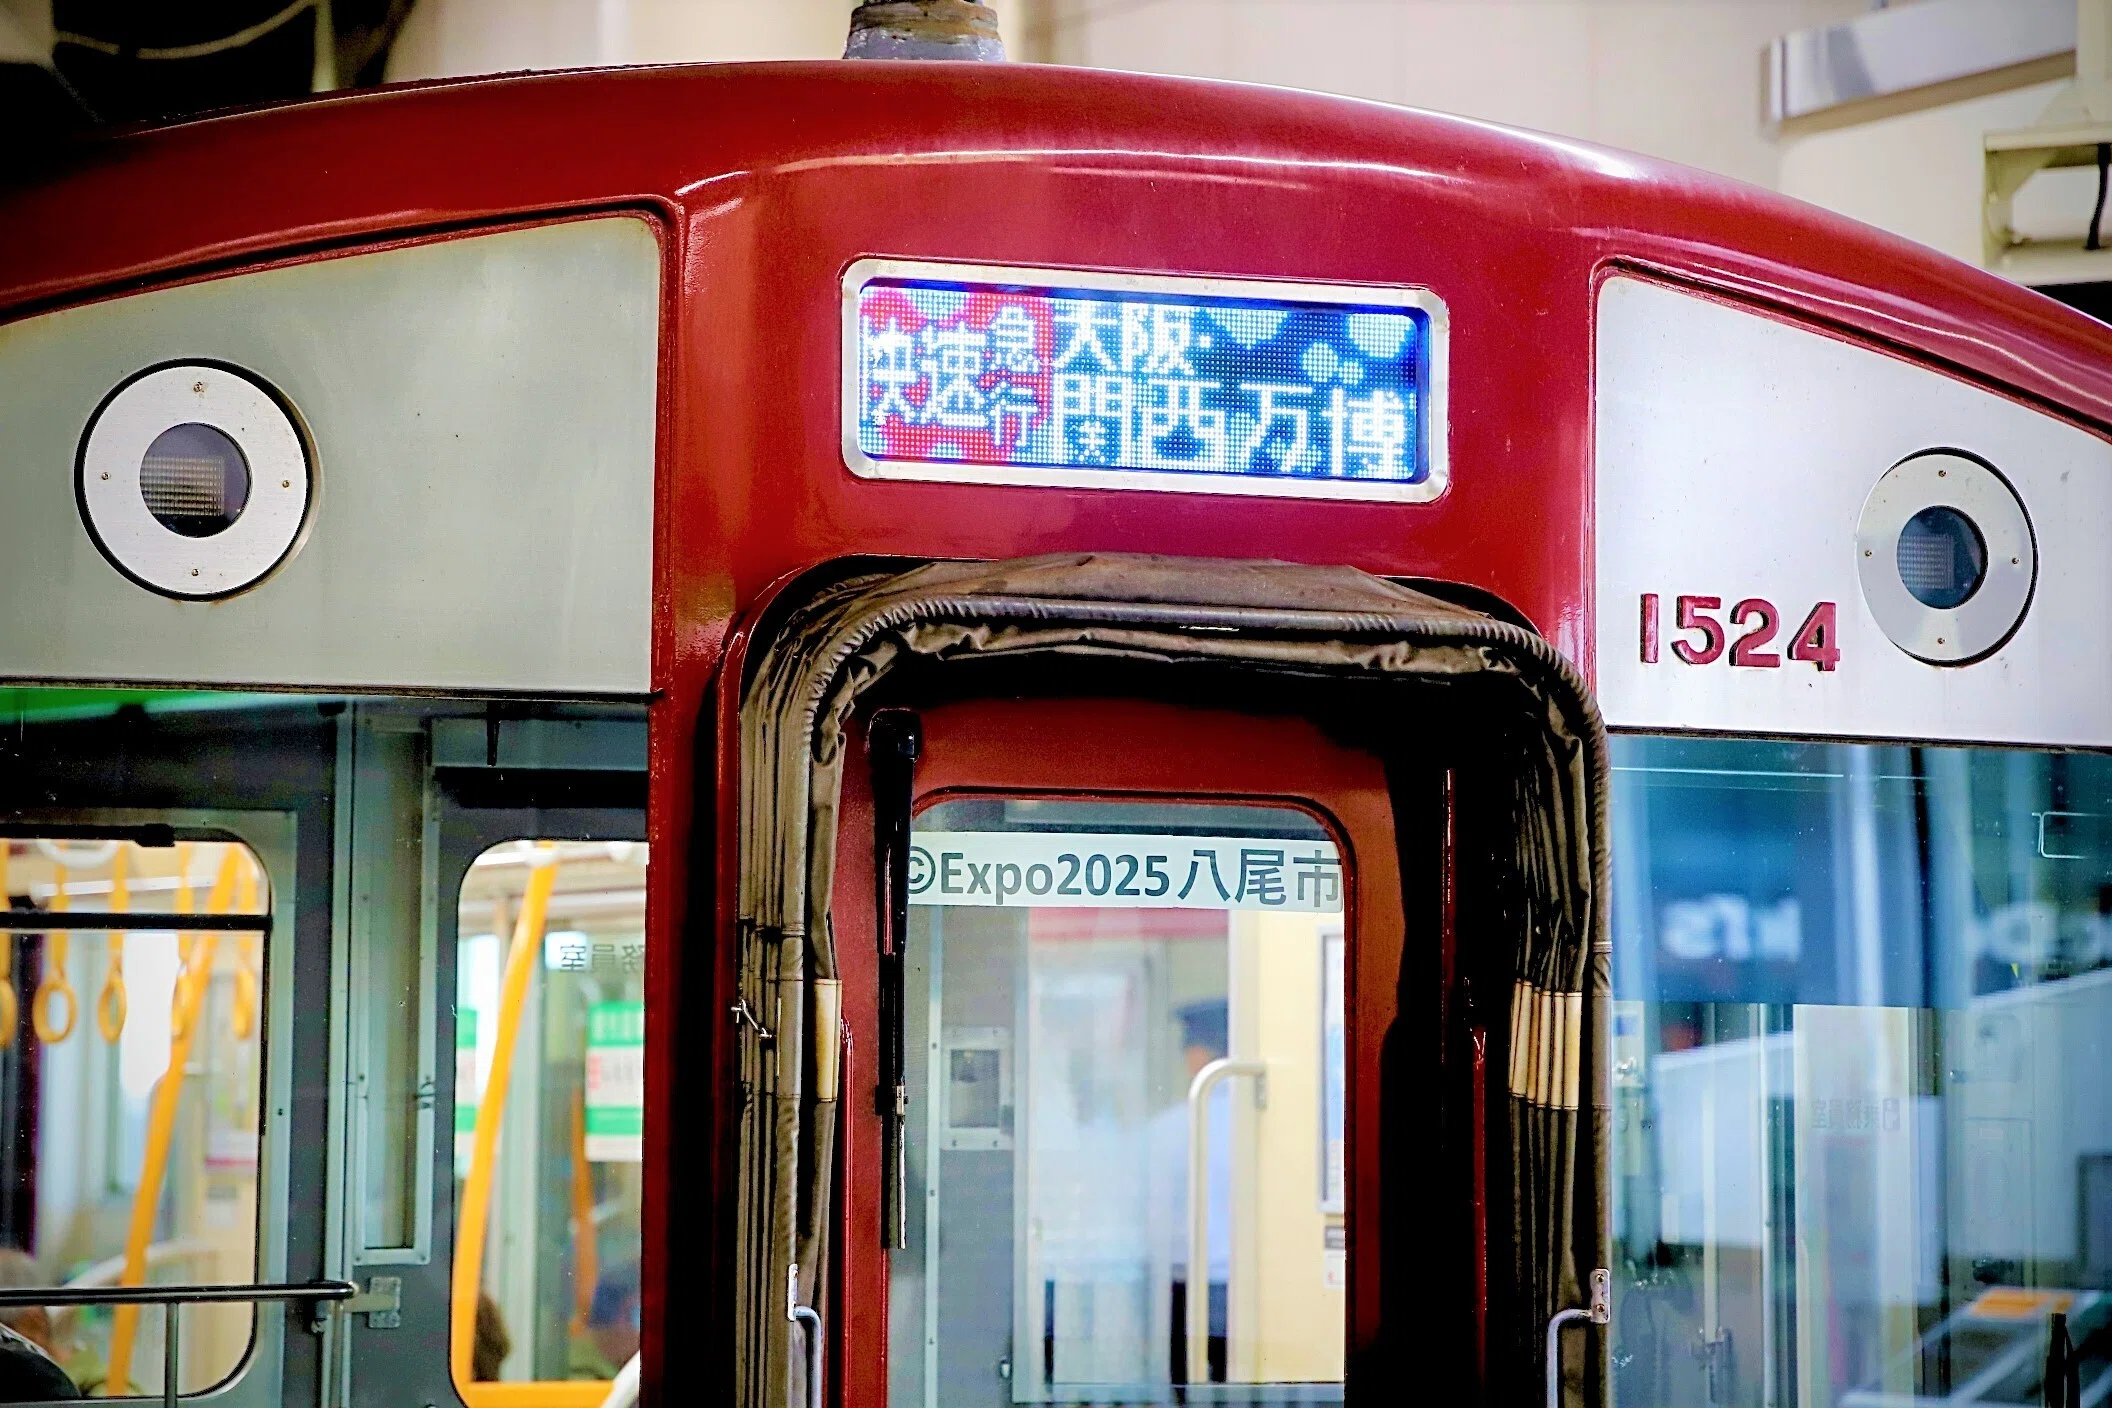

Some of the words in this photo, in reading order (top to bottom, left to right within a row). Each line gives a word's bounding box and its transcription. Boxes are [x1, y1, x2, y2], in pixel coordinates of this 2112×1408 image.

[1053, 373, 1405, 478] 関西万博
[1640, 593, 1840, 671] 1524
